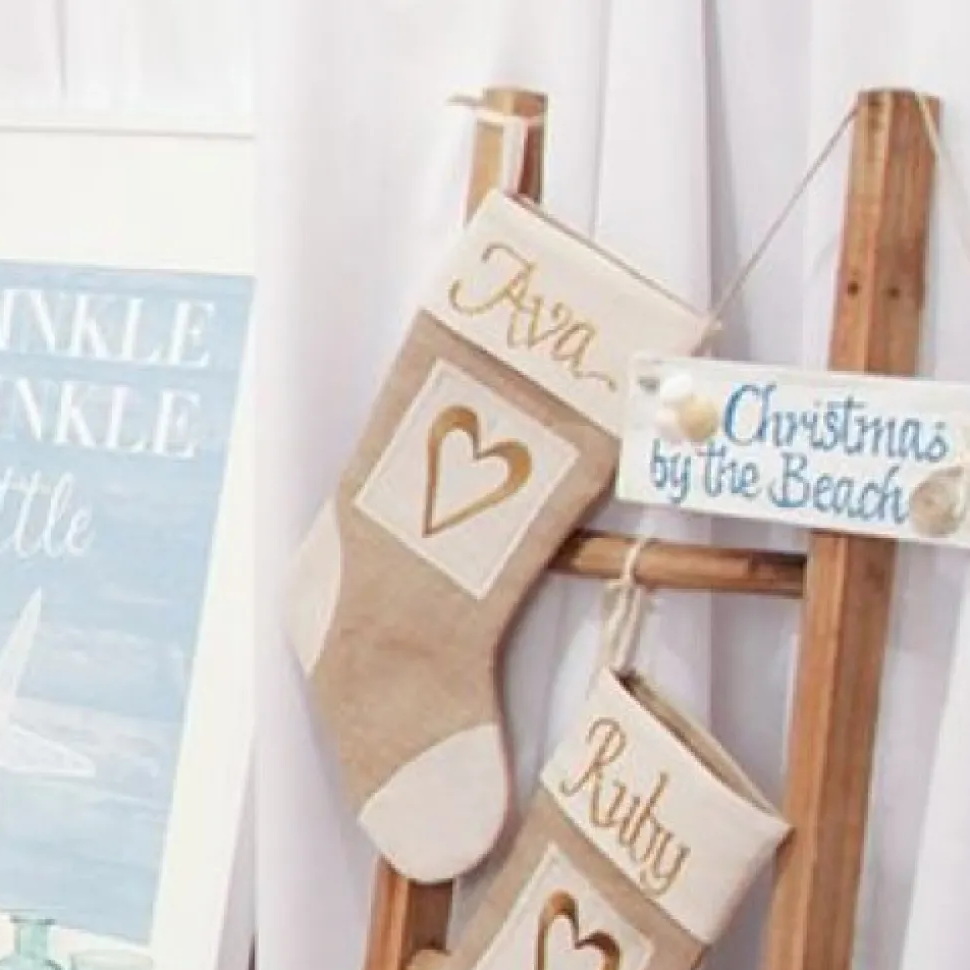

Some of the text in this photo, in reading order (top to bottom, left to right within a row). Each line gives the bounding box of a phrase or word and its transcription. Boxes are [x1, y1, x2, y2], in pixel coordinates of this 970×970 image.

[448, 242, 618, 392] Ava
[649, 438, 909, 524] by the Beach
[723, 382, 949, 462] Christmas
[560, 717, 691, 895] Ruby
